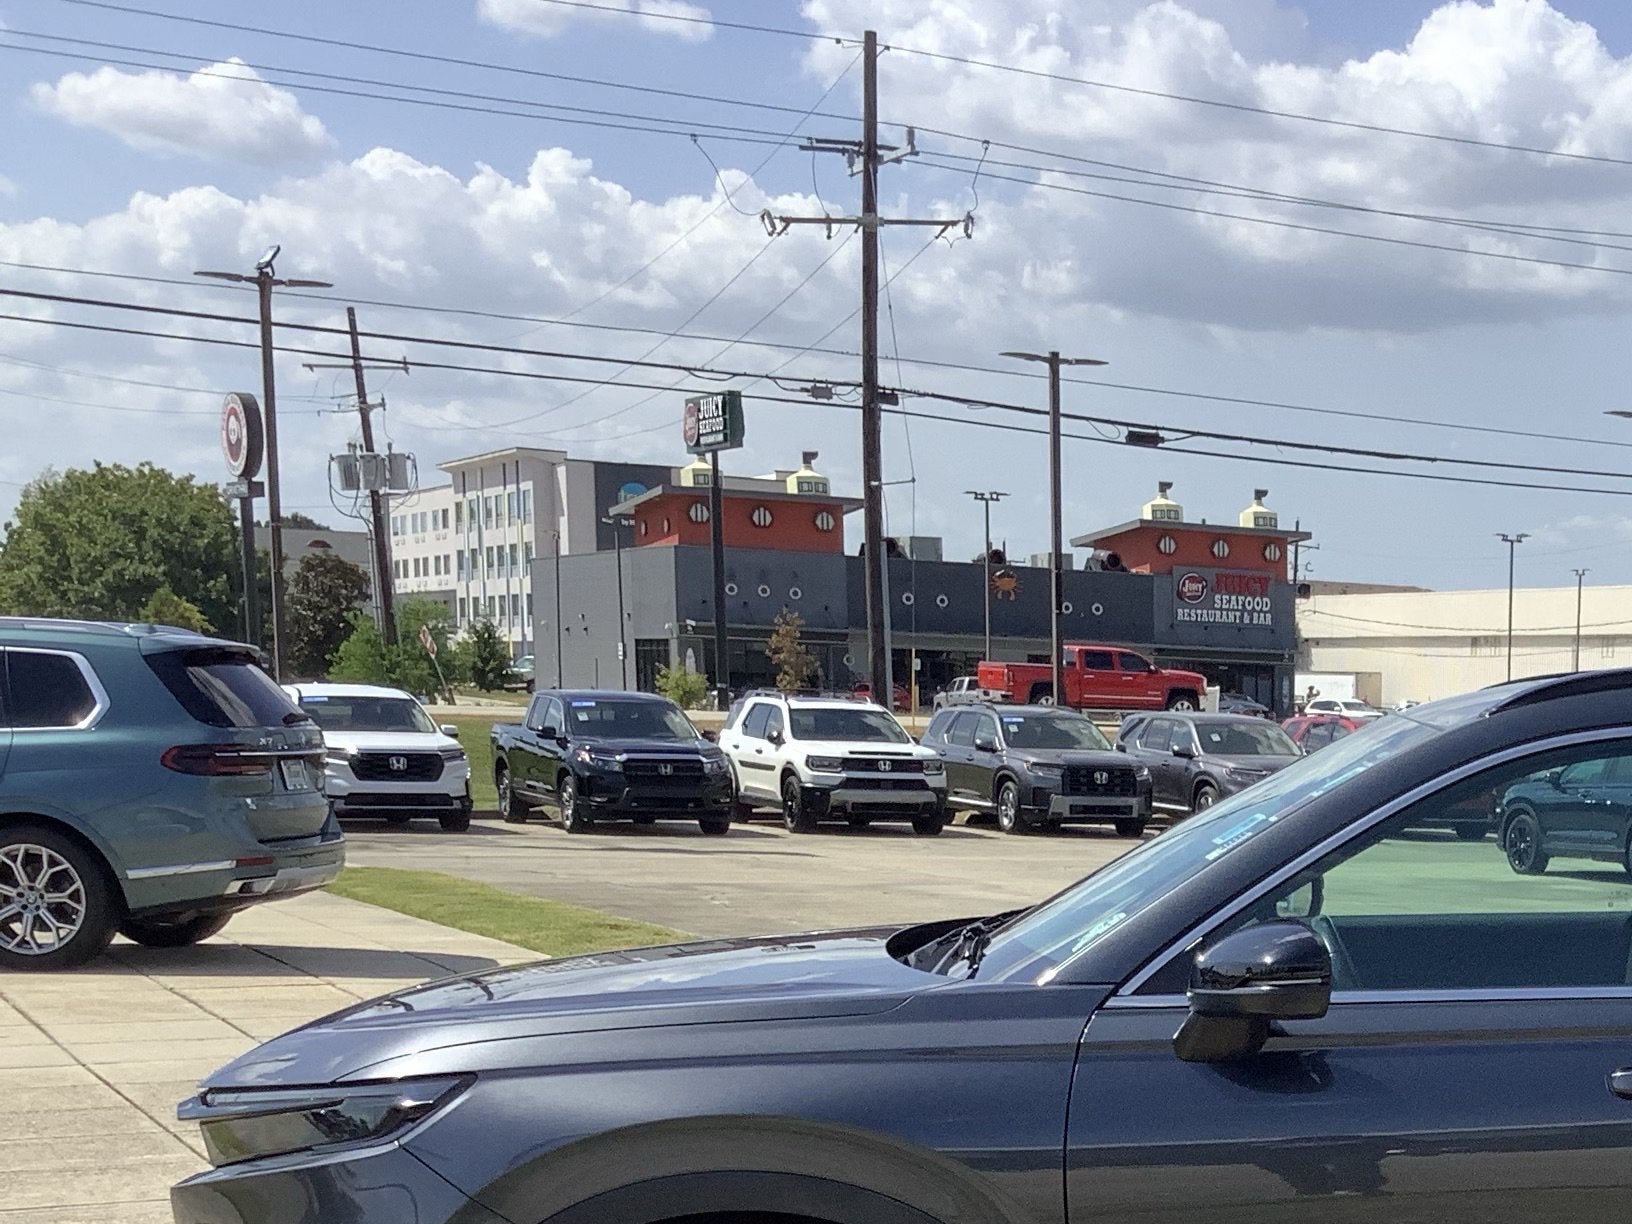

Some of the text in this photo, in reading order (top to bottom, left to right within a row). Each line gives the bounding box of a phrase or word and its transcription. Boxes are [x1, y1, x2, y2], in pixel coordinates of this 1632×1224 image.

[698, 394, 723, 420] JUICY
[699, 416, 724, 434] SEAFOOD
[1211, 573, 1269, 596] JUICY
[1214, 594, 1271, 612] SEAFOOD
[1177, 608, 1272, 626] RESTAURANT & BAR
